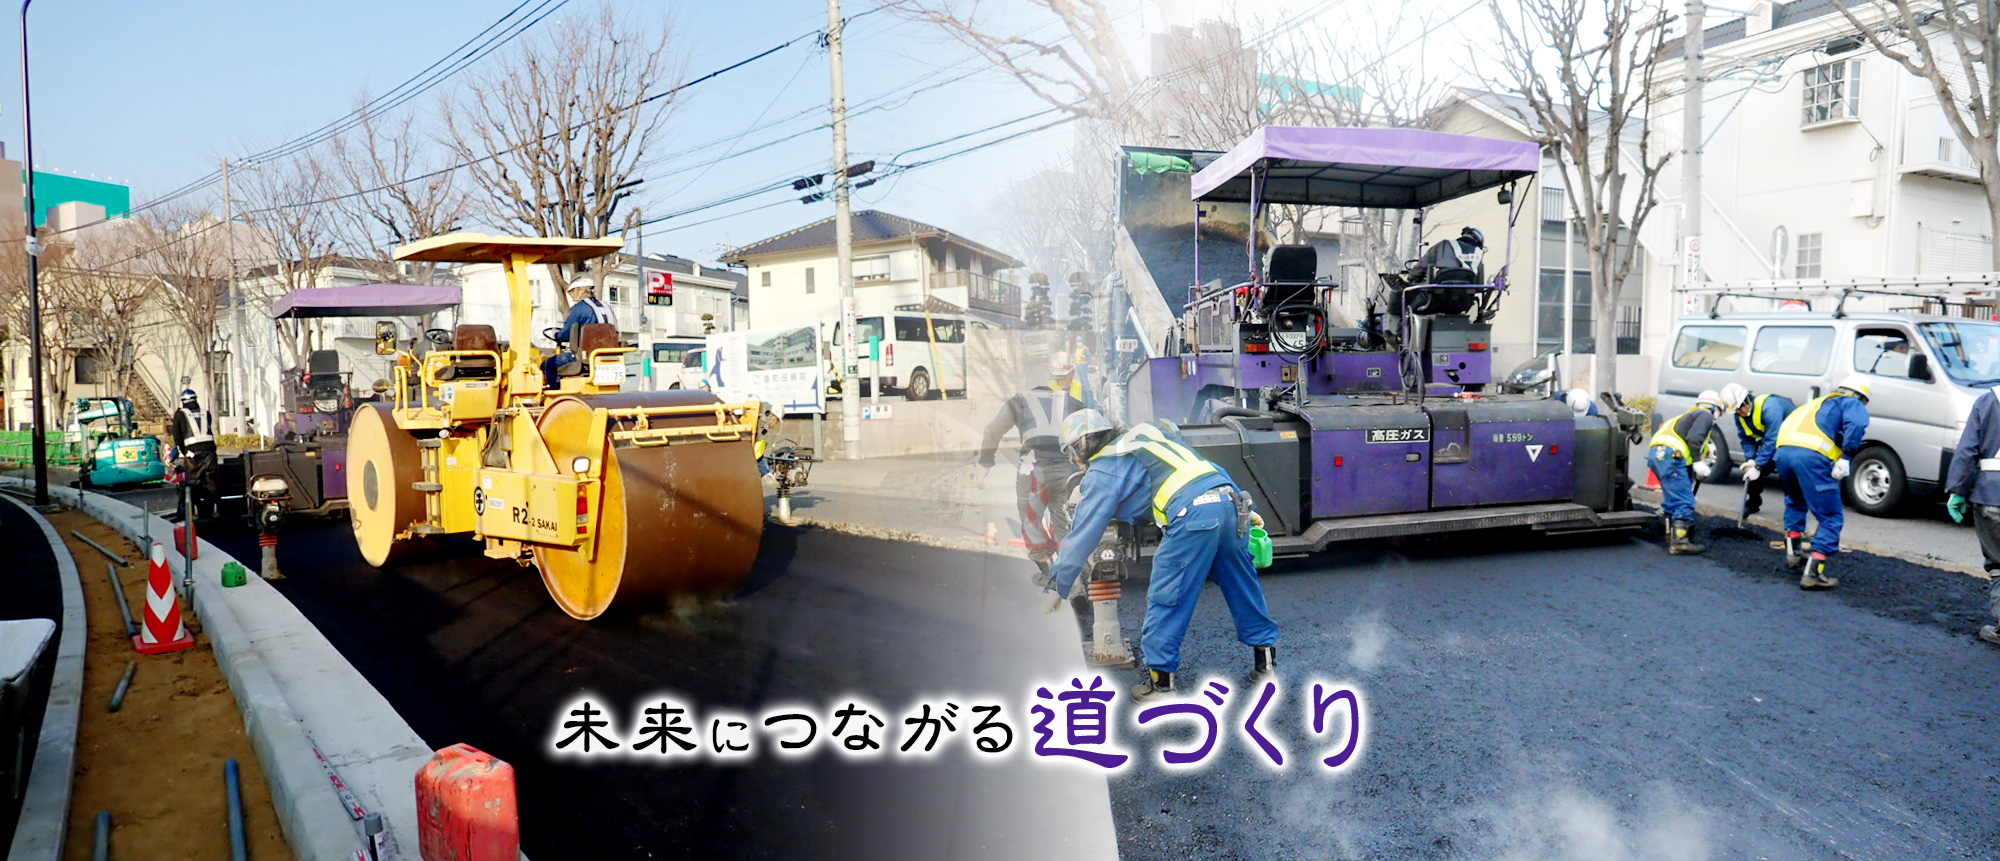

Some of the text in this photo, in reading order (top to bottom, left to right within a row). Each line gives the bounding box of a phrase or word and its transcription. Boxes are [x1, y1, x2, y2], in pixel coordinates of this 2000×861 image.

[649, 272, 665, 294] P
[614, 371, 625, 382] 75
[1371, 429, 1425, 442] 高圧ガス
[537, 518, 559, 532] SAKAI
